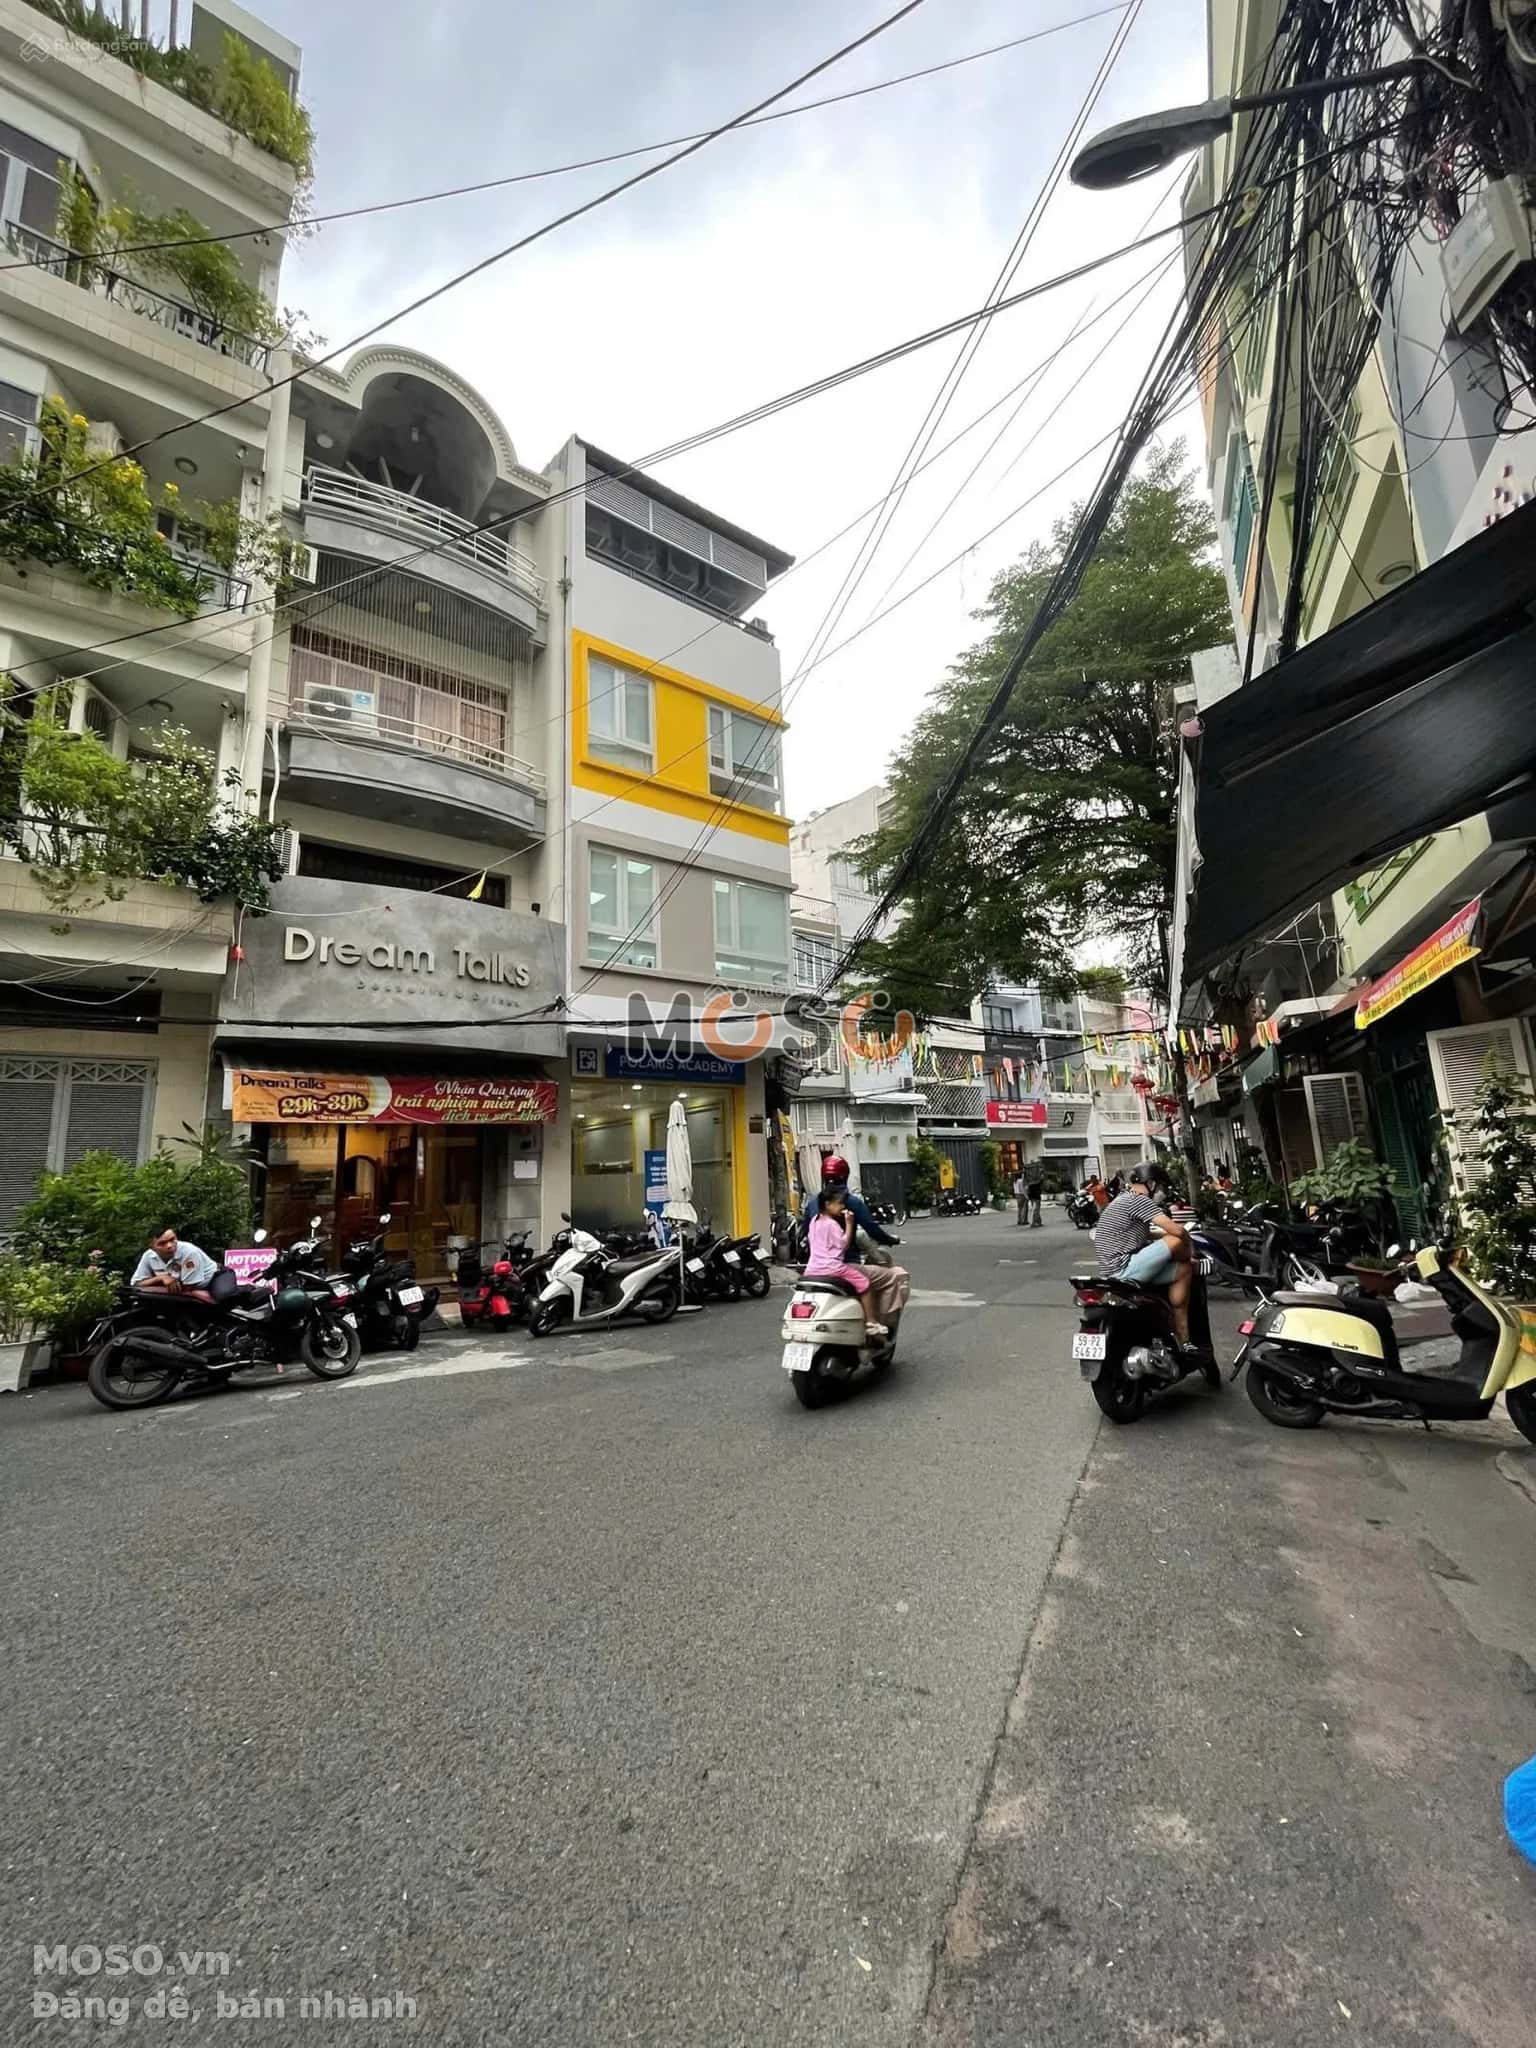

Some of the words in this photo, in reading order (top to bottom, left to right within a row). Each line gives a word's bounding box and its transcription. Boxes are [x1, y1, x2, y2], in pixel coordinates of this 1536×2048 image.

[284, 926, 434, 973] Dream
[453, 948, 530, 987] Talks
[619, 1054, 674, 1070] POLARIS
[678, 1058, 736, 1073] ACADEMY
[241, 1074, 289, 1089] Dream
[291, 1077, 326, 1090] Talks
[426, 1095, 478, 1110] nghiệm
[441, 1109, 470, 1122] dịch
